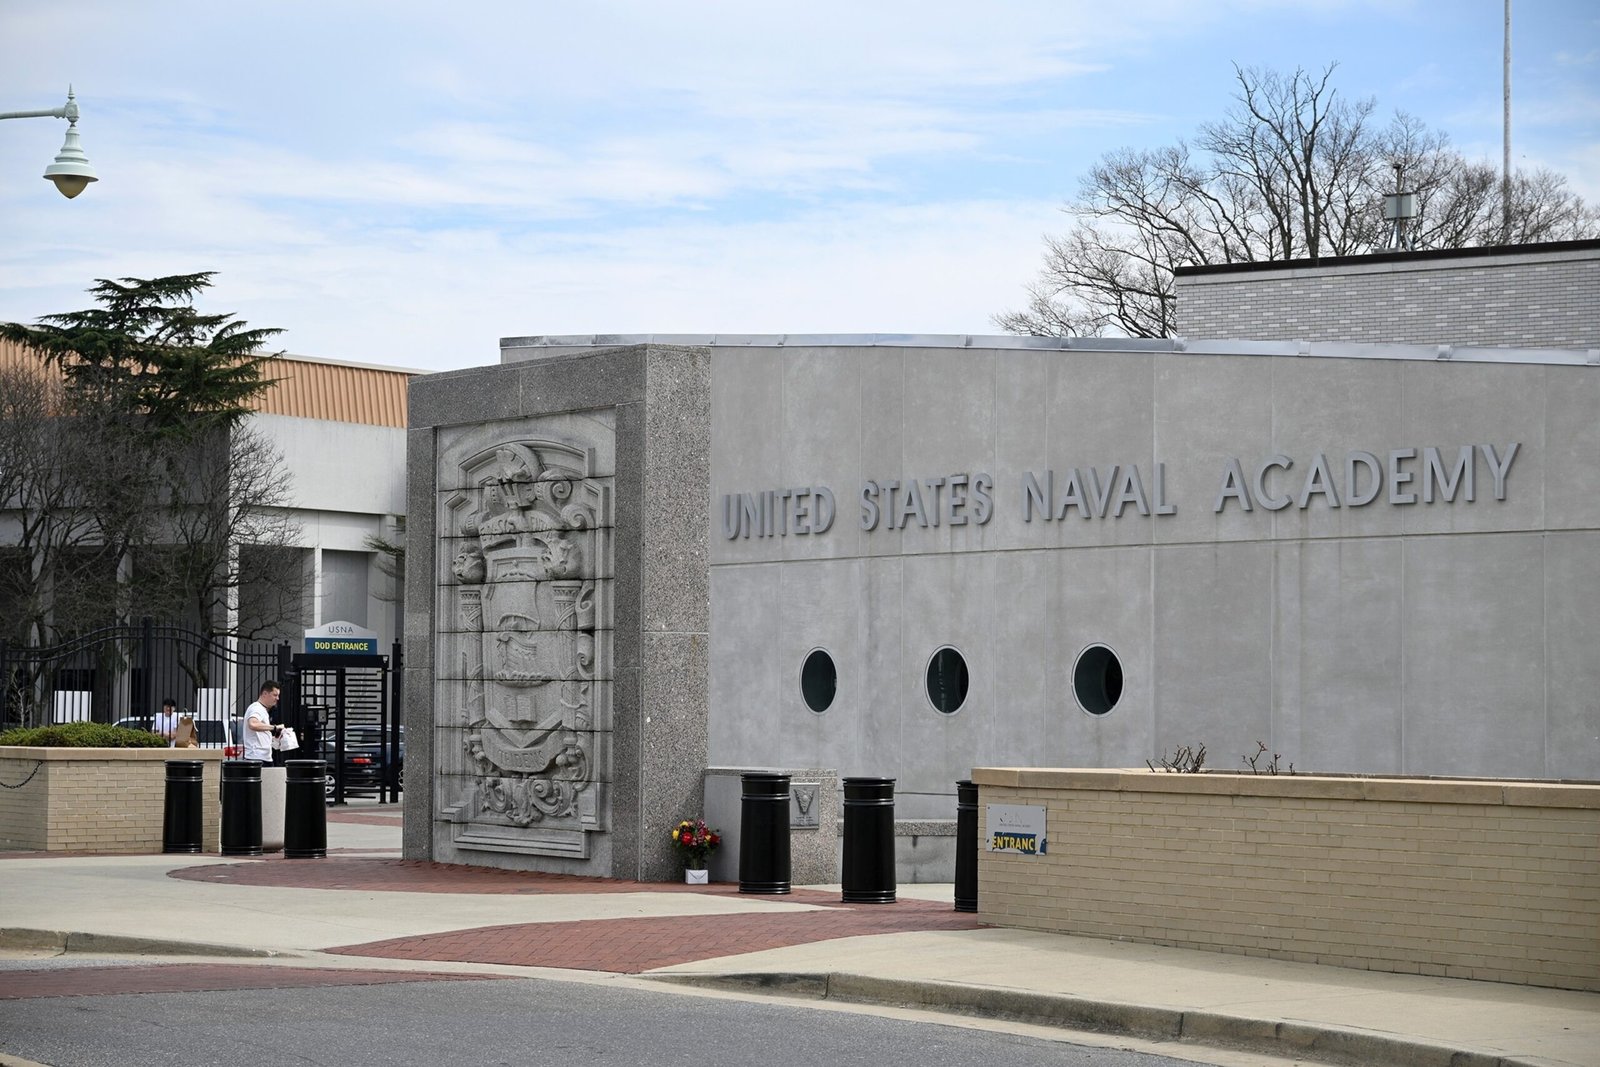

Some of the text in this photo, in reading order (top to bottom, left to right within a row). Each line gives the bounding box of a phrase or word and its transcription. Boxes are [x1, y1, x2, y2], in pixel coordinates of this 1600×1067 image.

[721, 442, 1521, 541] UNITED STATES NAVAL ACADEMY
[314, 641, 369, 651] DOD ENTRANCE
